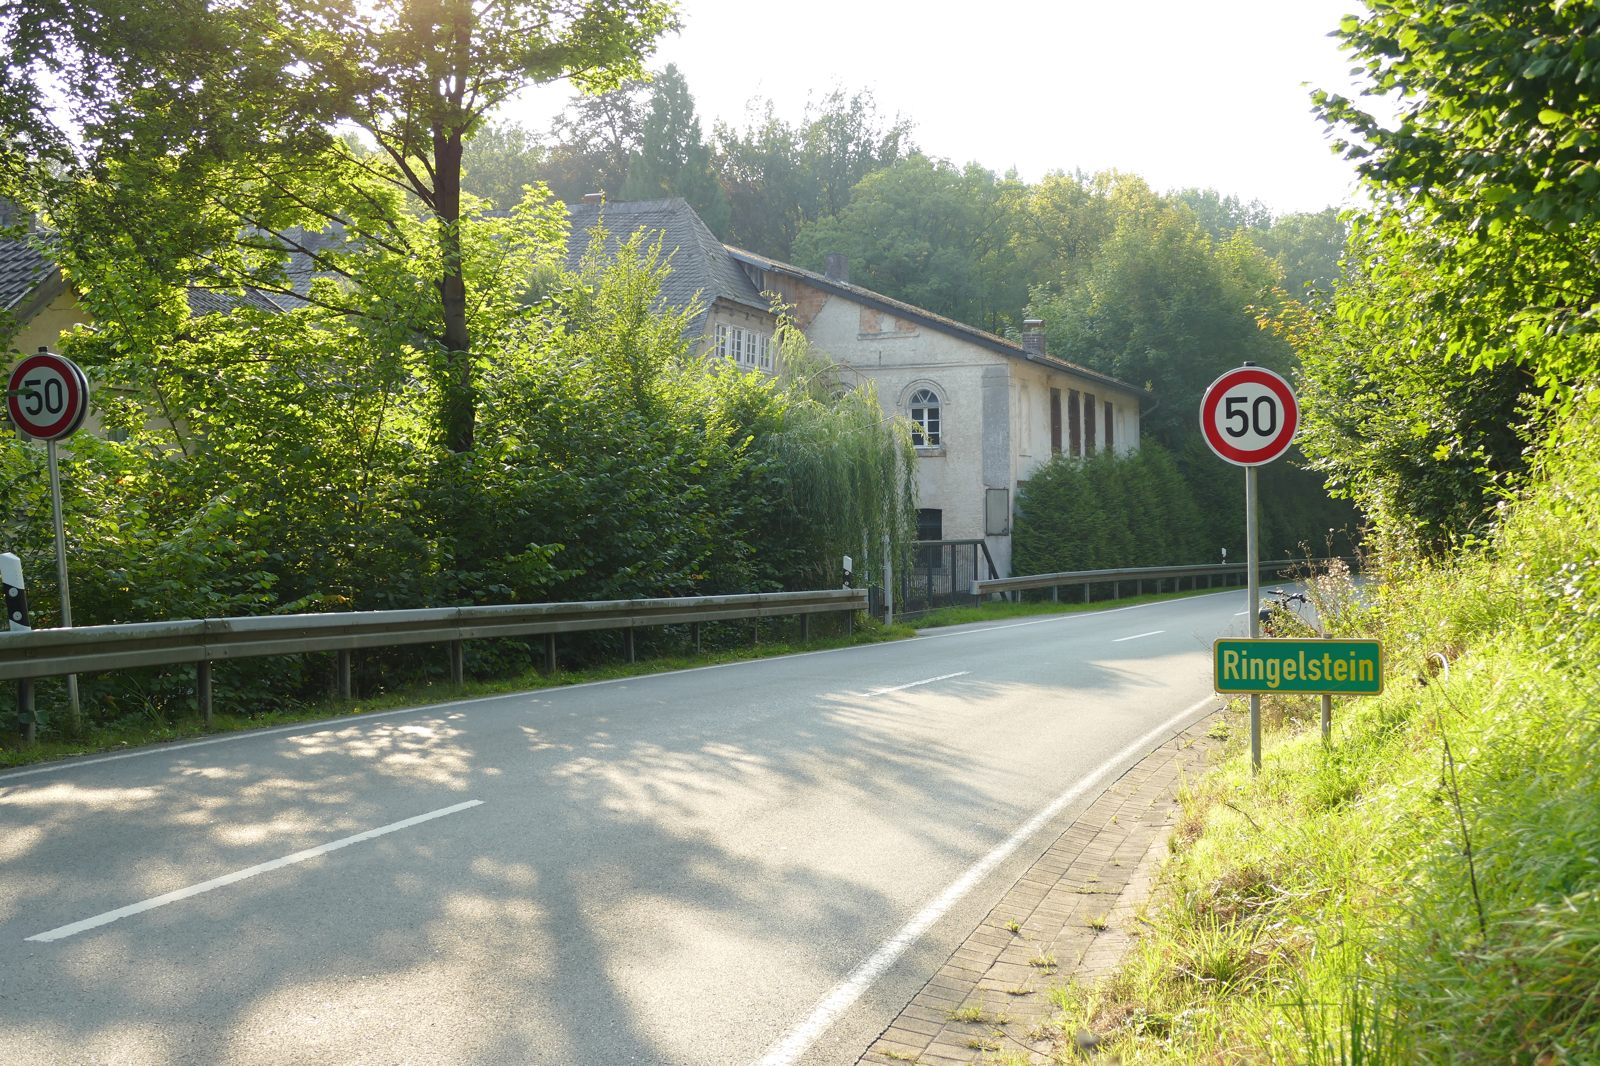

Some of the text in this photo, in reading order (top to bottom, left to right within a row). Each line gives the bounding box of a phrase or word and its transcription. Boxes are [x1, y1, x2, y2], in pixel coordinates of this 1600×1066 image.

[24, 378, 63, 416] 50
[1225, 395, 1277, 438] 50
[1223, 650, 1374, 688] Ringelstein
